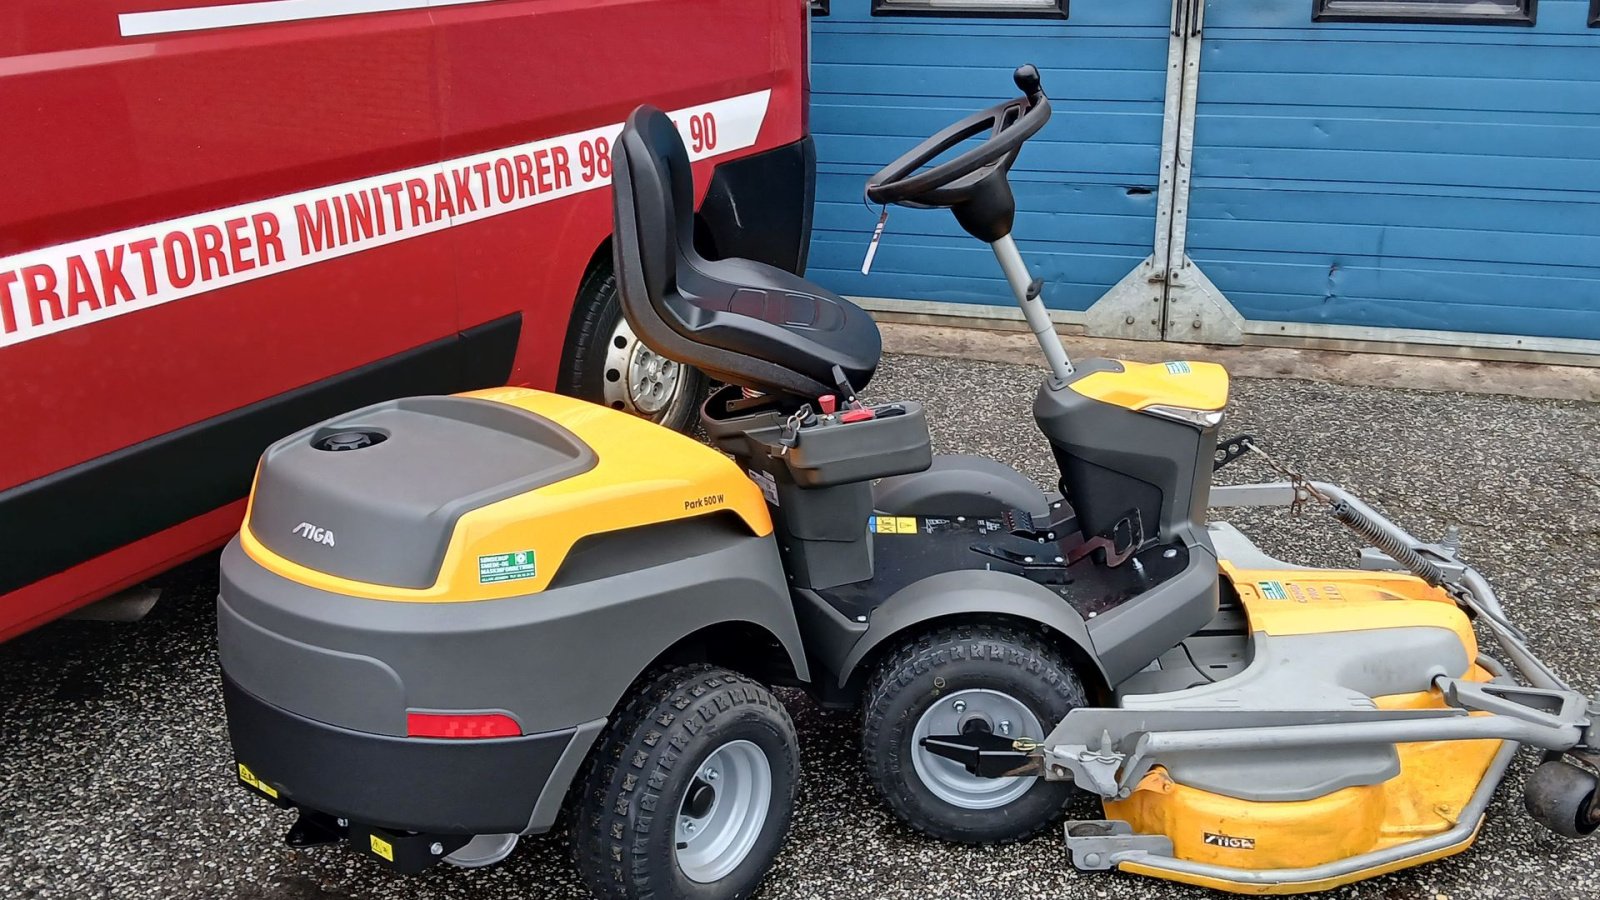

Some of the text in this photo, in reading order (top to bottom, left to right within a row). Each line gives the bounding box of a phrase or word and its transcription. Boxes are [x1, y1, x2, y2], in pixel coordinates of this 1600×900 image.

[294, 146, 572, 255] MINITRAKTORER
[579, 137, 611, 182] 98
[690, 112, 717, 153] 90
[685, 494, 724, 510] Park 500 W
[292, 522, 335, 547] STIGA
[1205, 835, 1255, 849] STIGA
